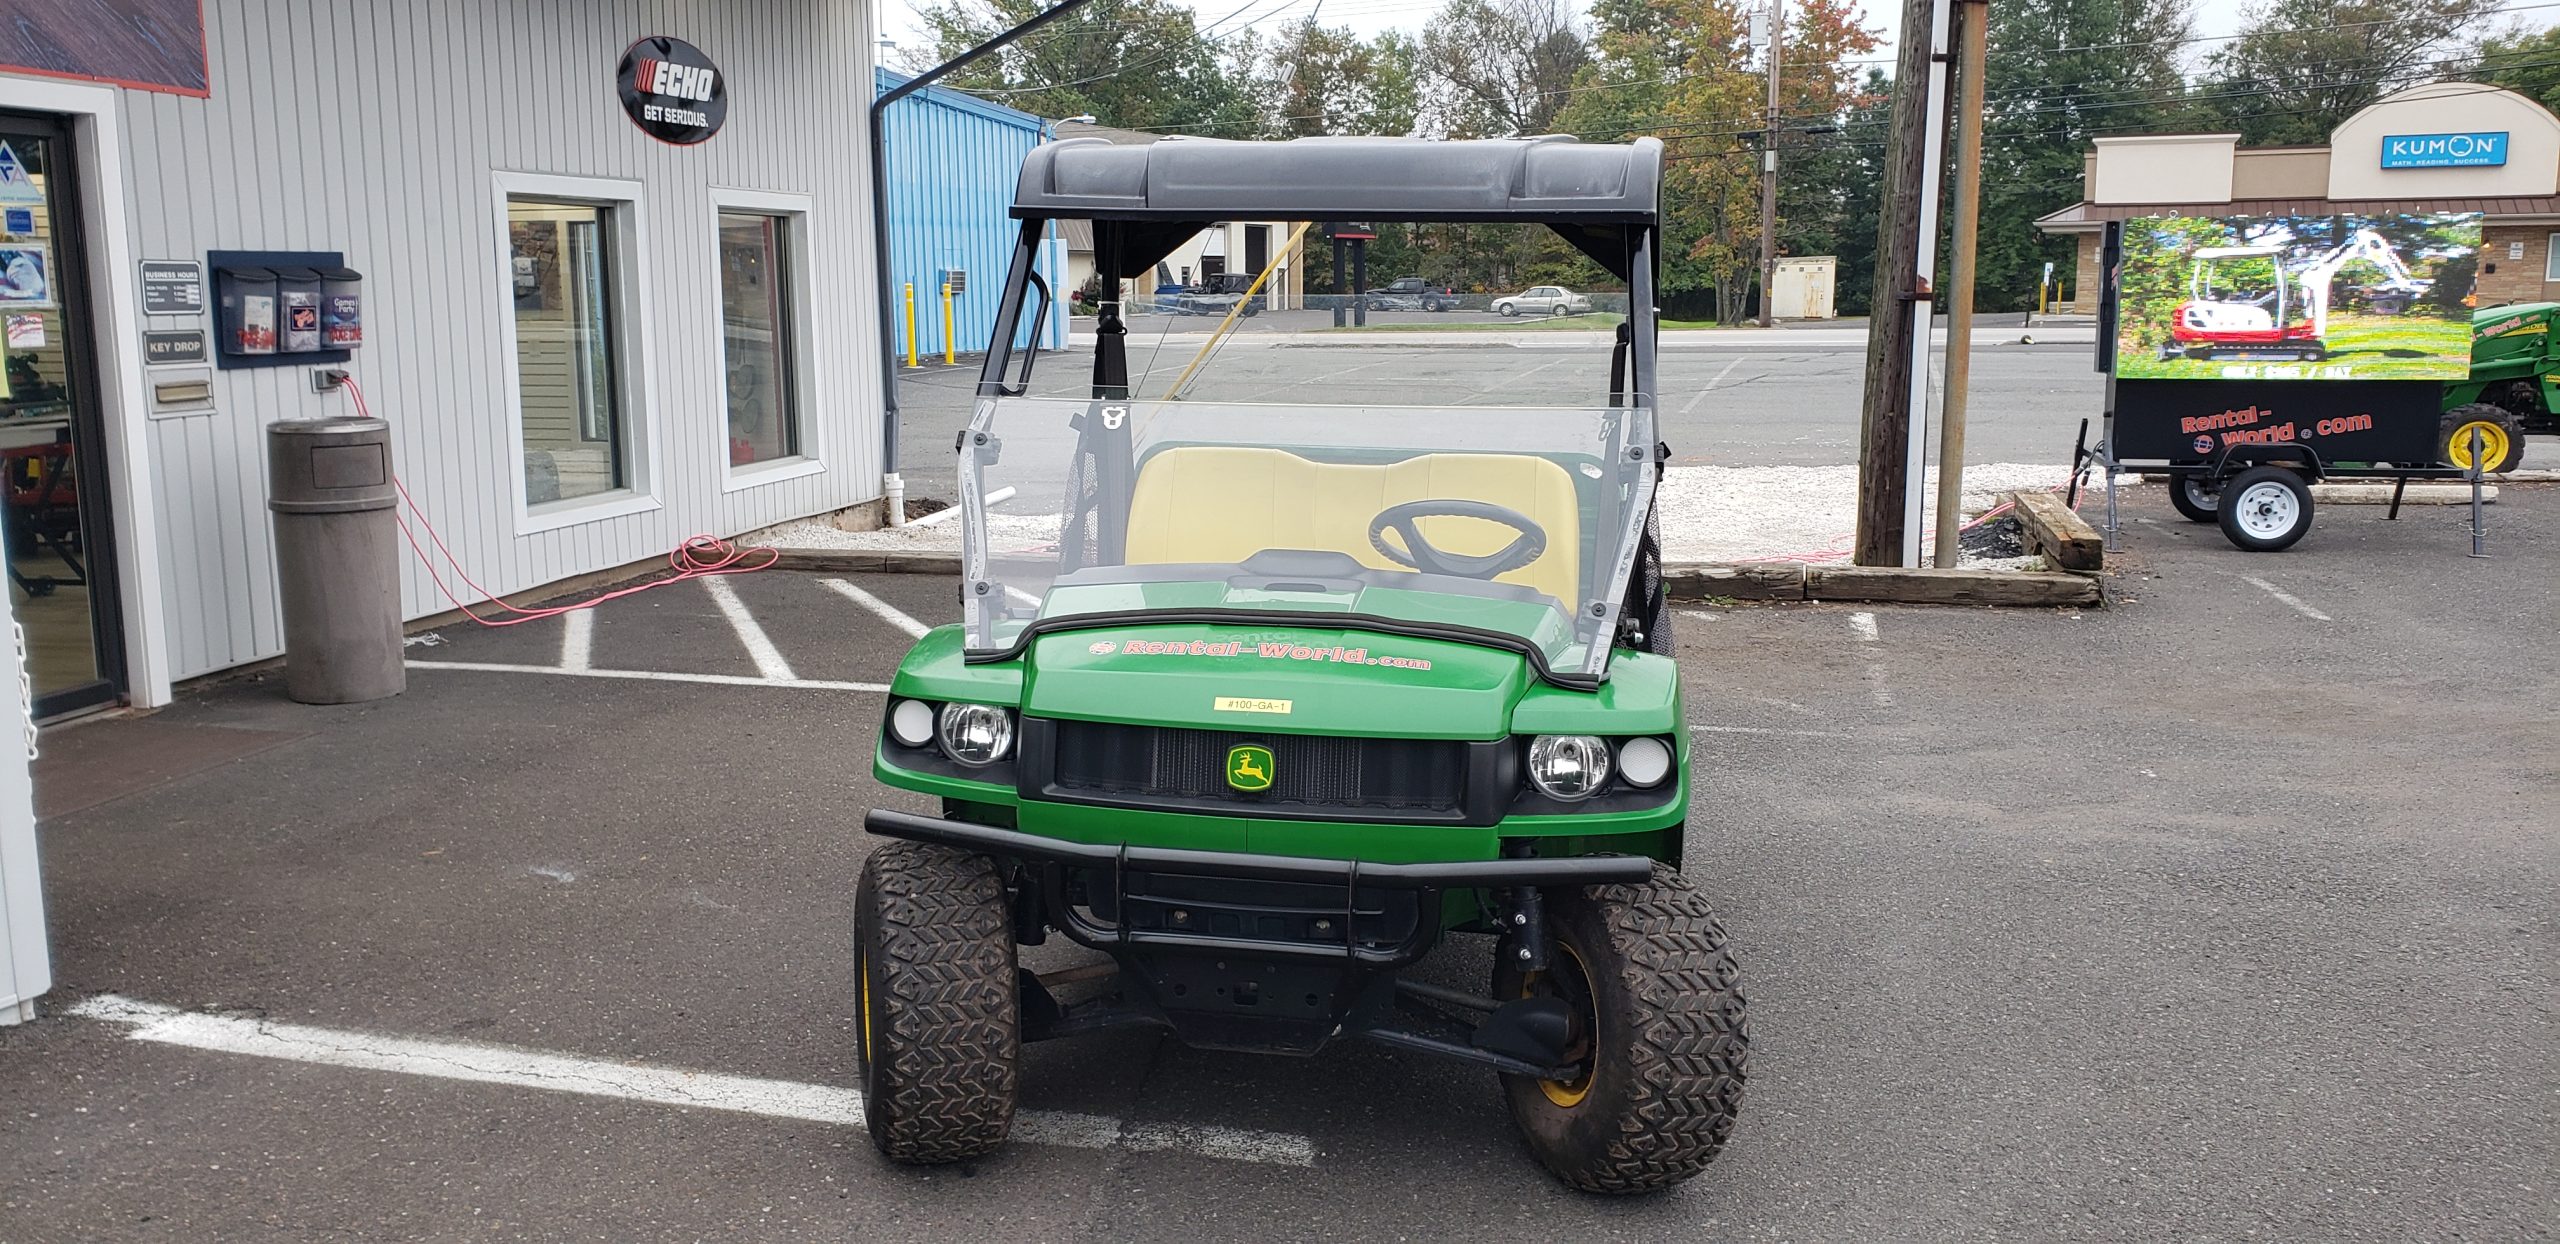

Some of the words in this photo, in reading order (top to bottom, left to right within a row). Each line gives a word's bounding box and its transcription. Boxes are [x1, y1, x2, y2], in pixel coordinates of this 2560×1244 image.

[652, 61, 714, 102] ECHO
[644, 104, 663, 121] GET
[664, 108, 709, 128] SERIOUS.
[2392, 136, 2498, 156] KUMON
[145, 271, 176, 279] BUSINESS
[338, 305, 354, 314] Party
[150, 342, 171, 353] KEY
[174, 341, 201, 352] DROP
[2181, 406, 2272, 434] Rental-
[1121, 640, 1432, 671] Rental-World.com
[1227, 700, 1285, 711] #100-GA-1
